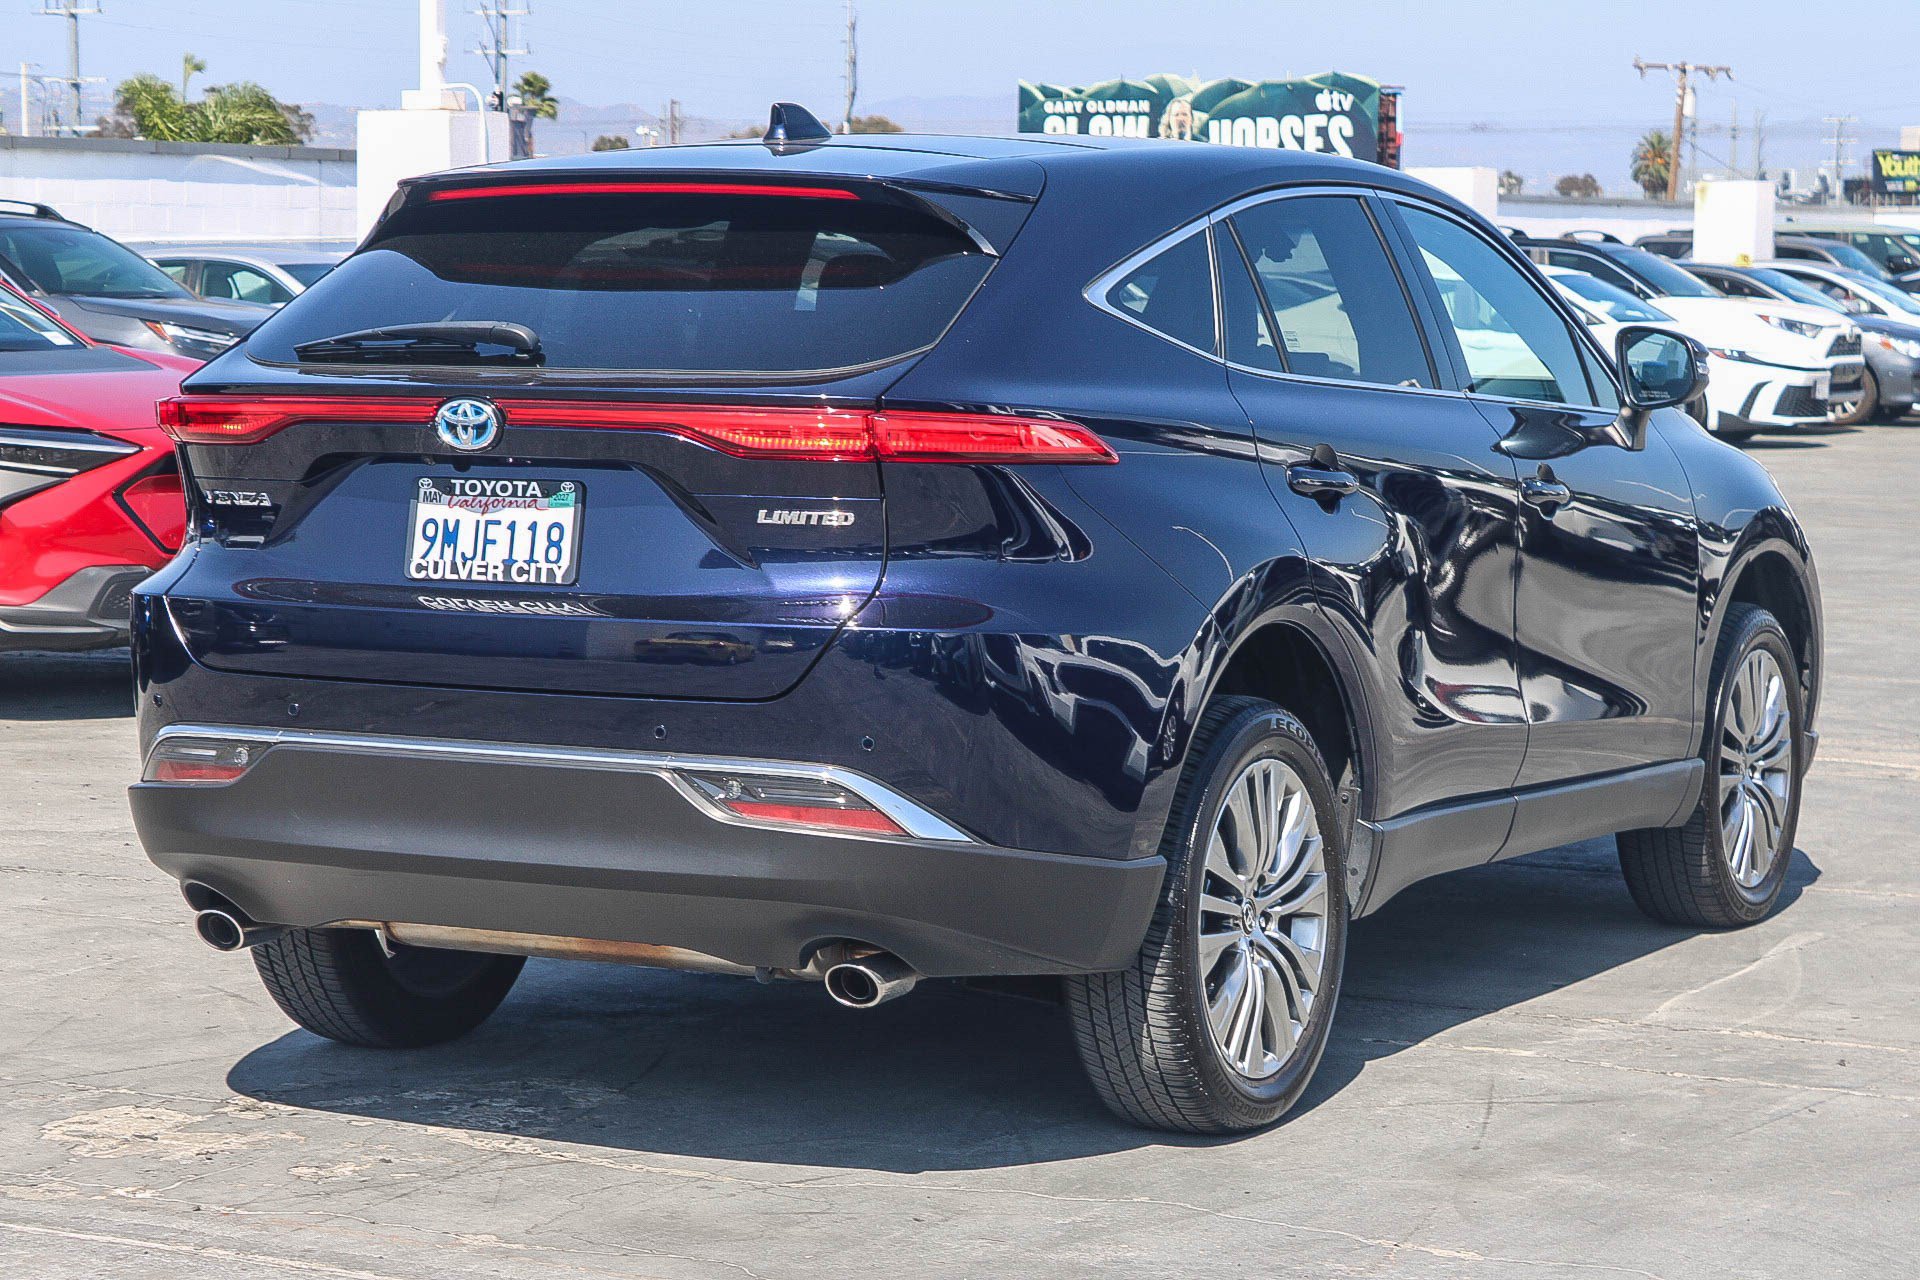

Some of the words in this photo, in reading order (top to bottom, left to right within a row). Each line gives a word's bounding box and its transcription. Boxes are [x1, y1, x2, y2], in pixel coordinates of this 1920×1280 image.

[1043, 100, 1083, 114] GARY
[1085, 99, 1151, 114] OLDMAN
[422, 490, 443, 504] MAY
[451, 479, 543, 498] TOYOTA
[447, 495, 549, 516] California
[756, 509, 856, 527] LIMITED
[421, 517, 565, 566] 9MJF118
[409, 558, 505, 582] CULVER
[510, 562, 570, 584] CITY
